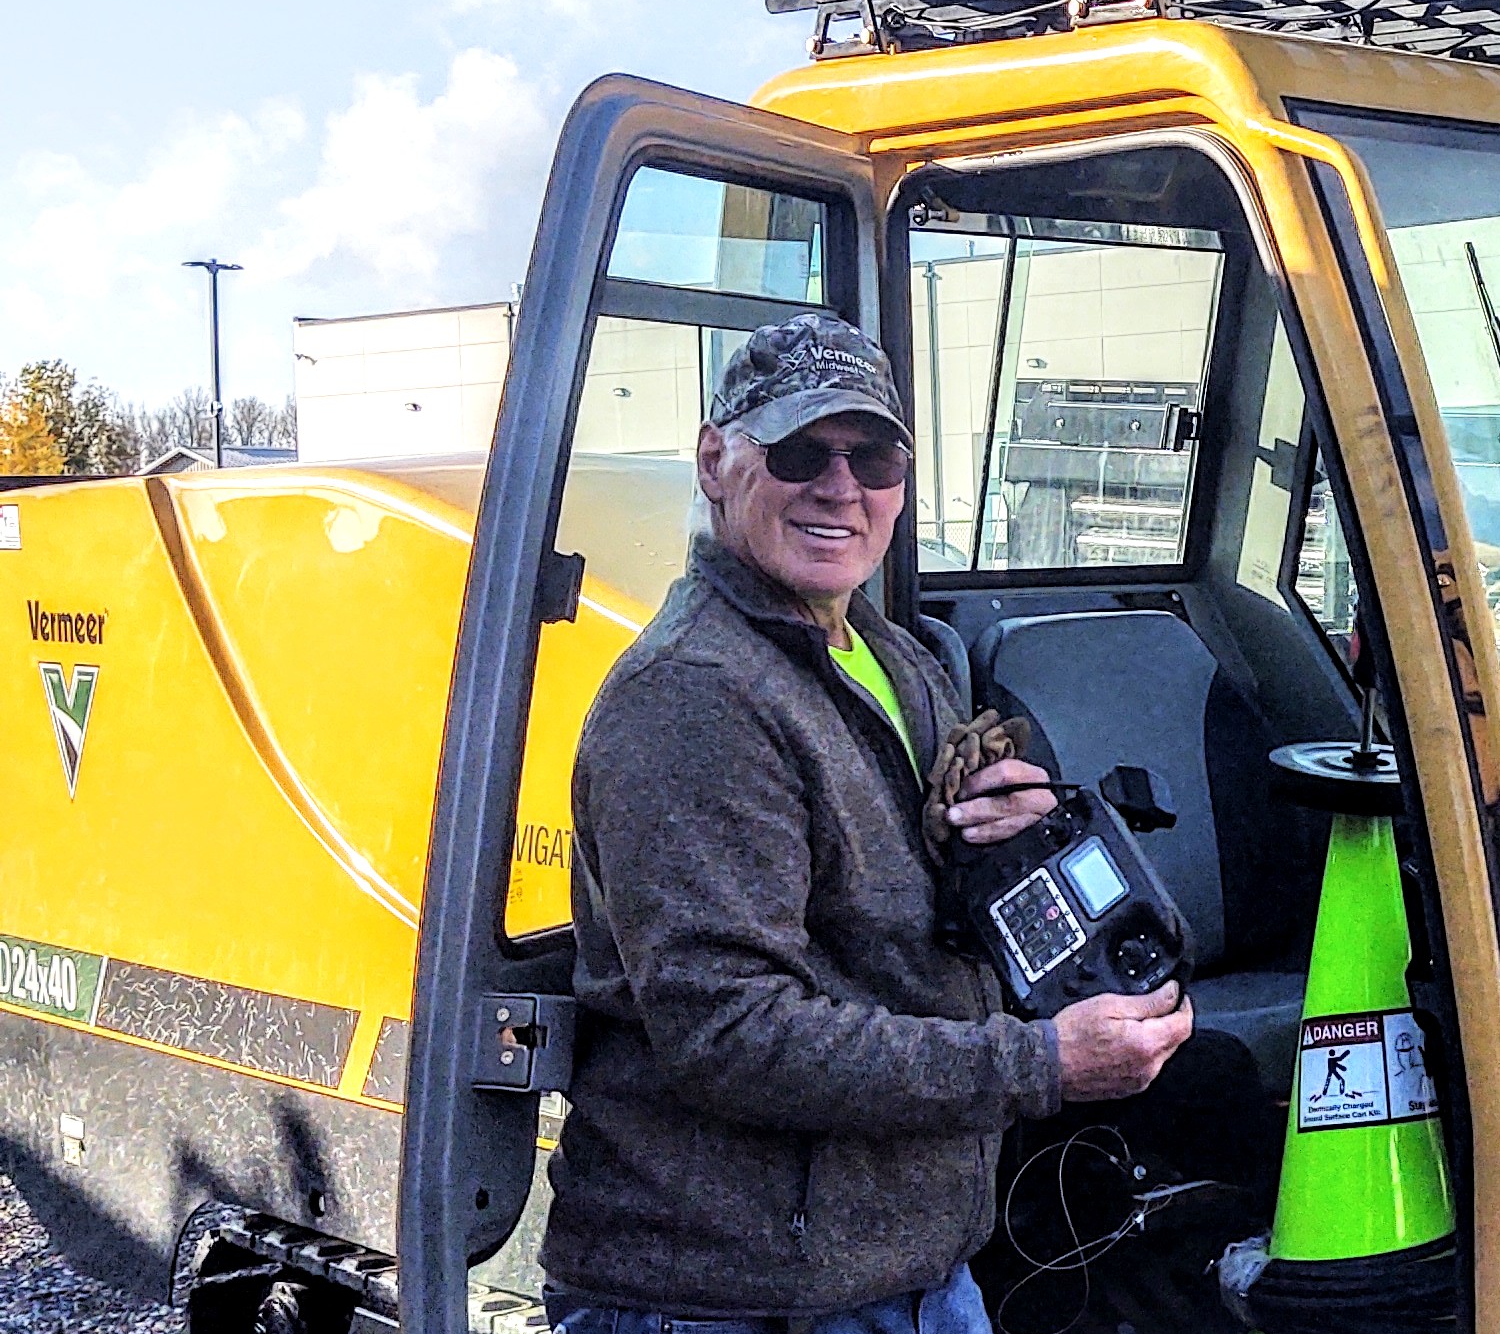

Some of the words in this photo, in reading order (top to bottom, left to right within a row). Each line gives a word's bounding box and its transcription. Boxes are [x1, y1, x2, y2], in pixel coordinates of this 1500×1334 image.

[810, 346, 877, 375] Vermeer
[27, 599, 105, 645] Vermeer
[1313, 1020, 1379, 1041] DANGER
